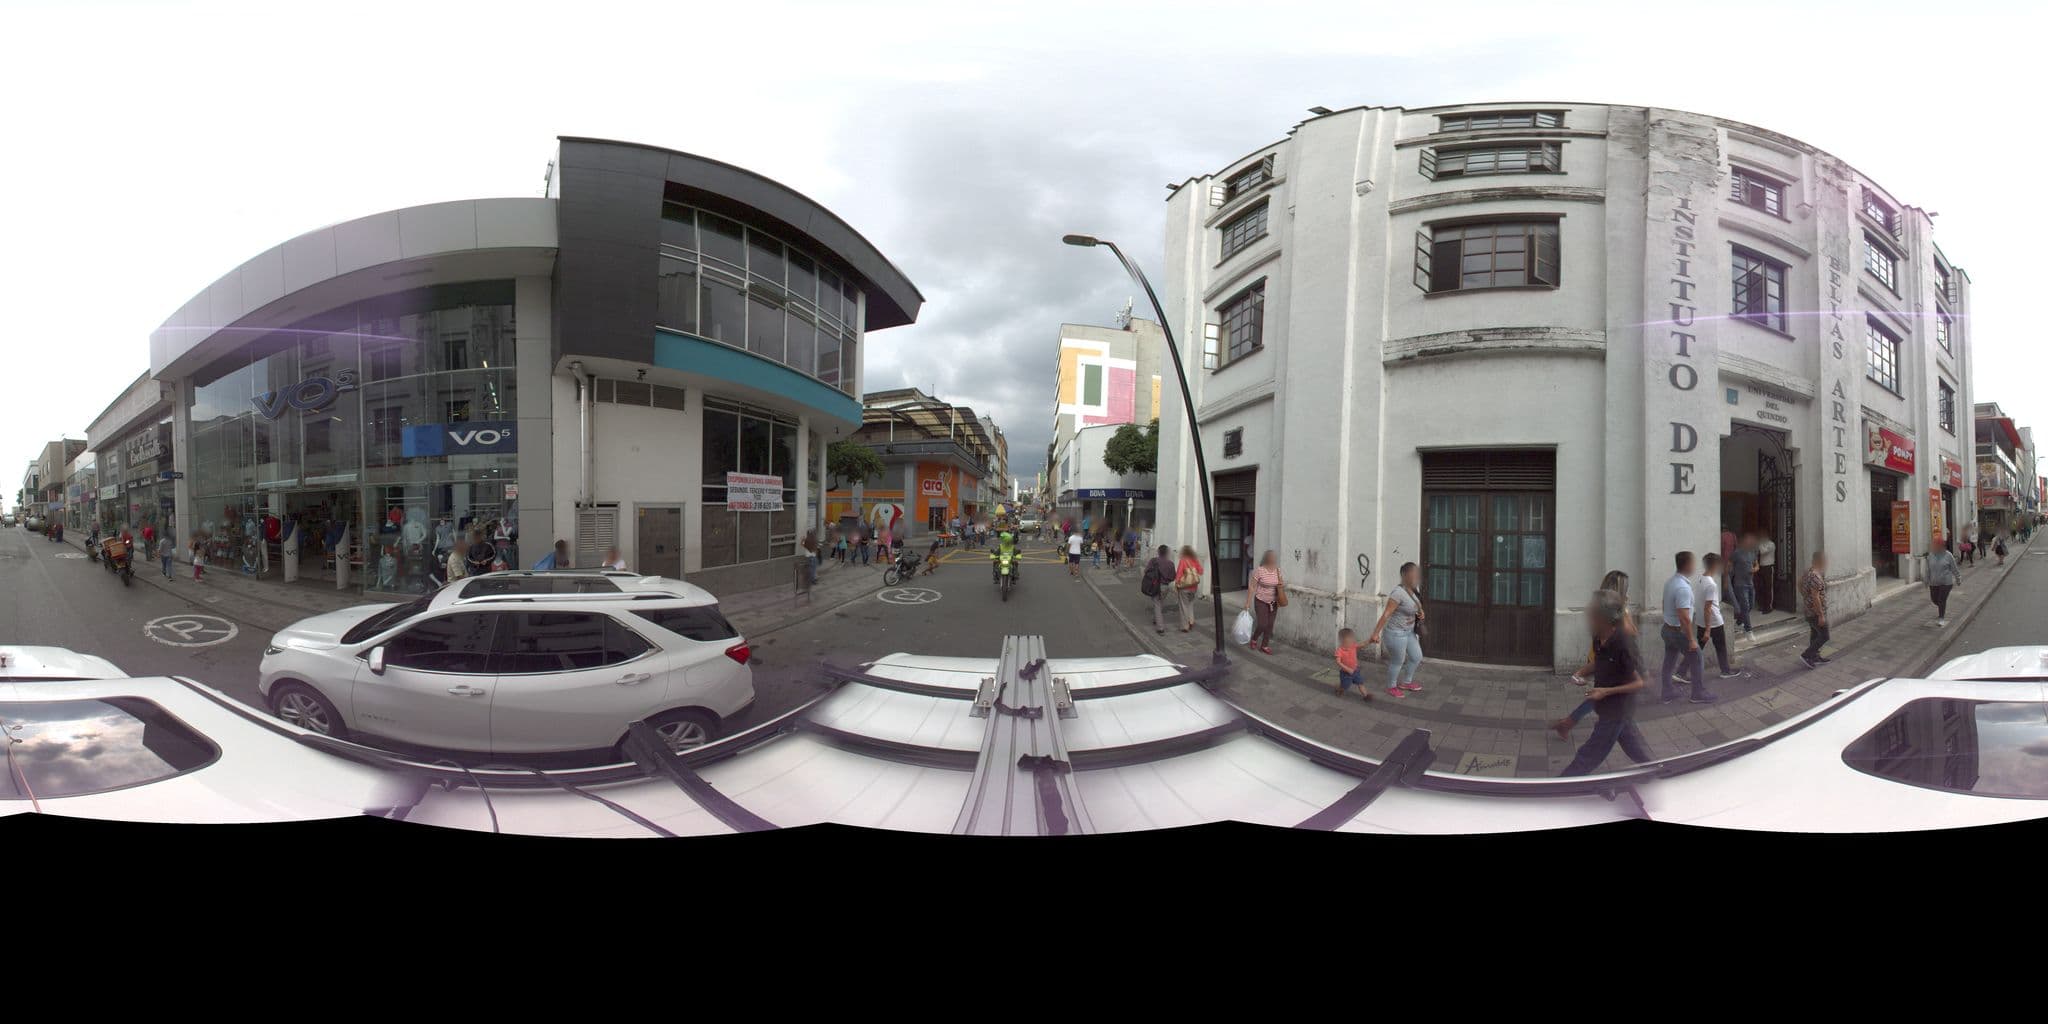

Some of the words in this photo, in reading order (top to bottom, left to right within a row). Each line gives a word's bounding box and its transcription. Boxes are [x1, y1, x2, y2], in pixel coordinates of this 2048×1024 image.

[1668, 197, 1698, 391] INSTITUTO
[1829, 255, 1844, 360] BELLAS
[1745, 384, 1796, 404] UNIVERSIDAD
[1766, 401, 1780, 411] DEL
[1669, 421, 1698, 495] DE
[1832, 378, 1847, 503] ARTES
[923, 480, 943, 491] ara
[1125, 490, 1144, 498] BBVA
